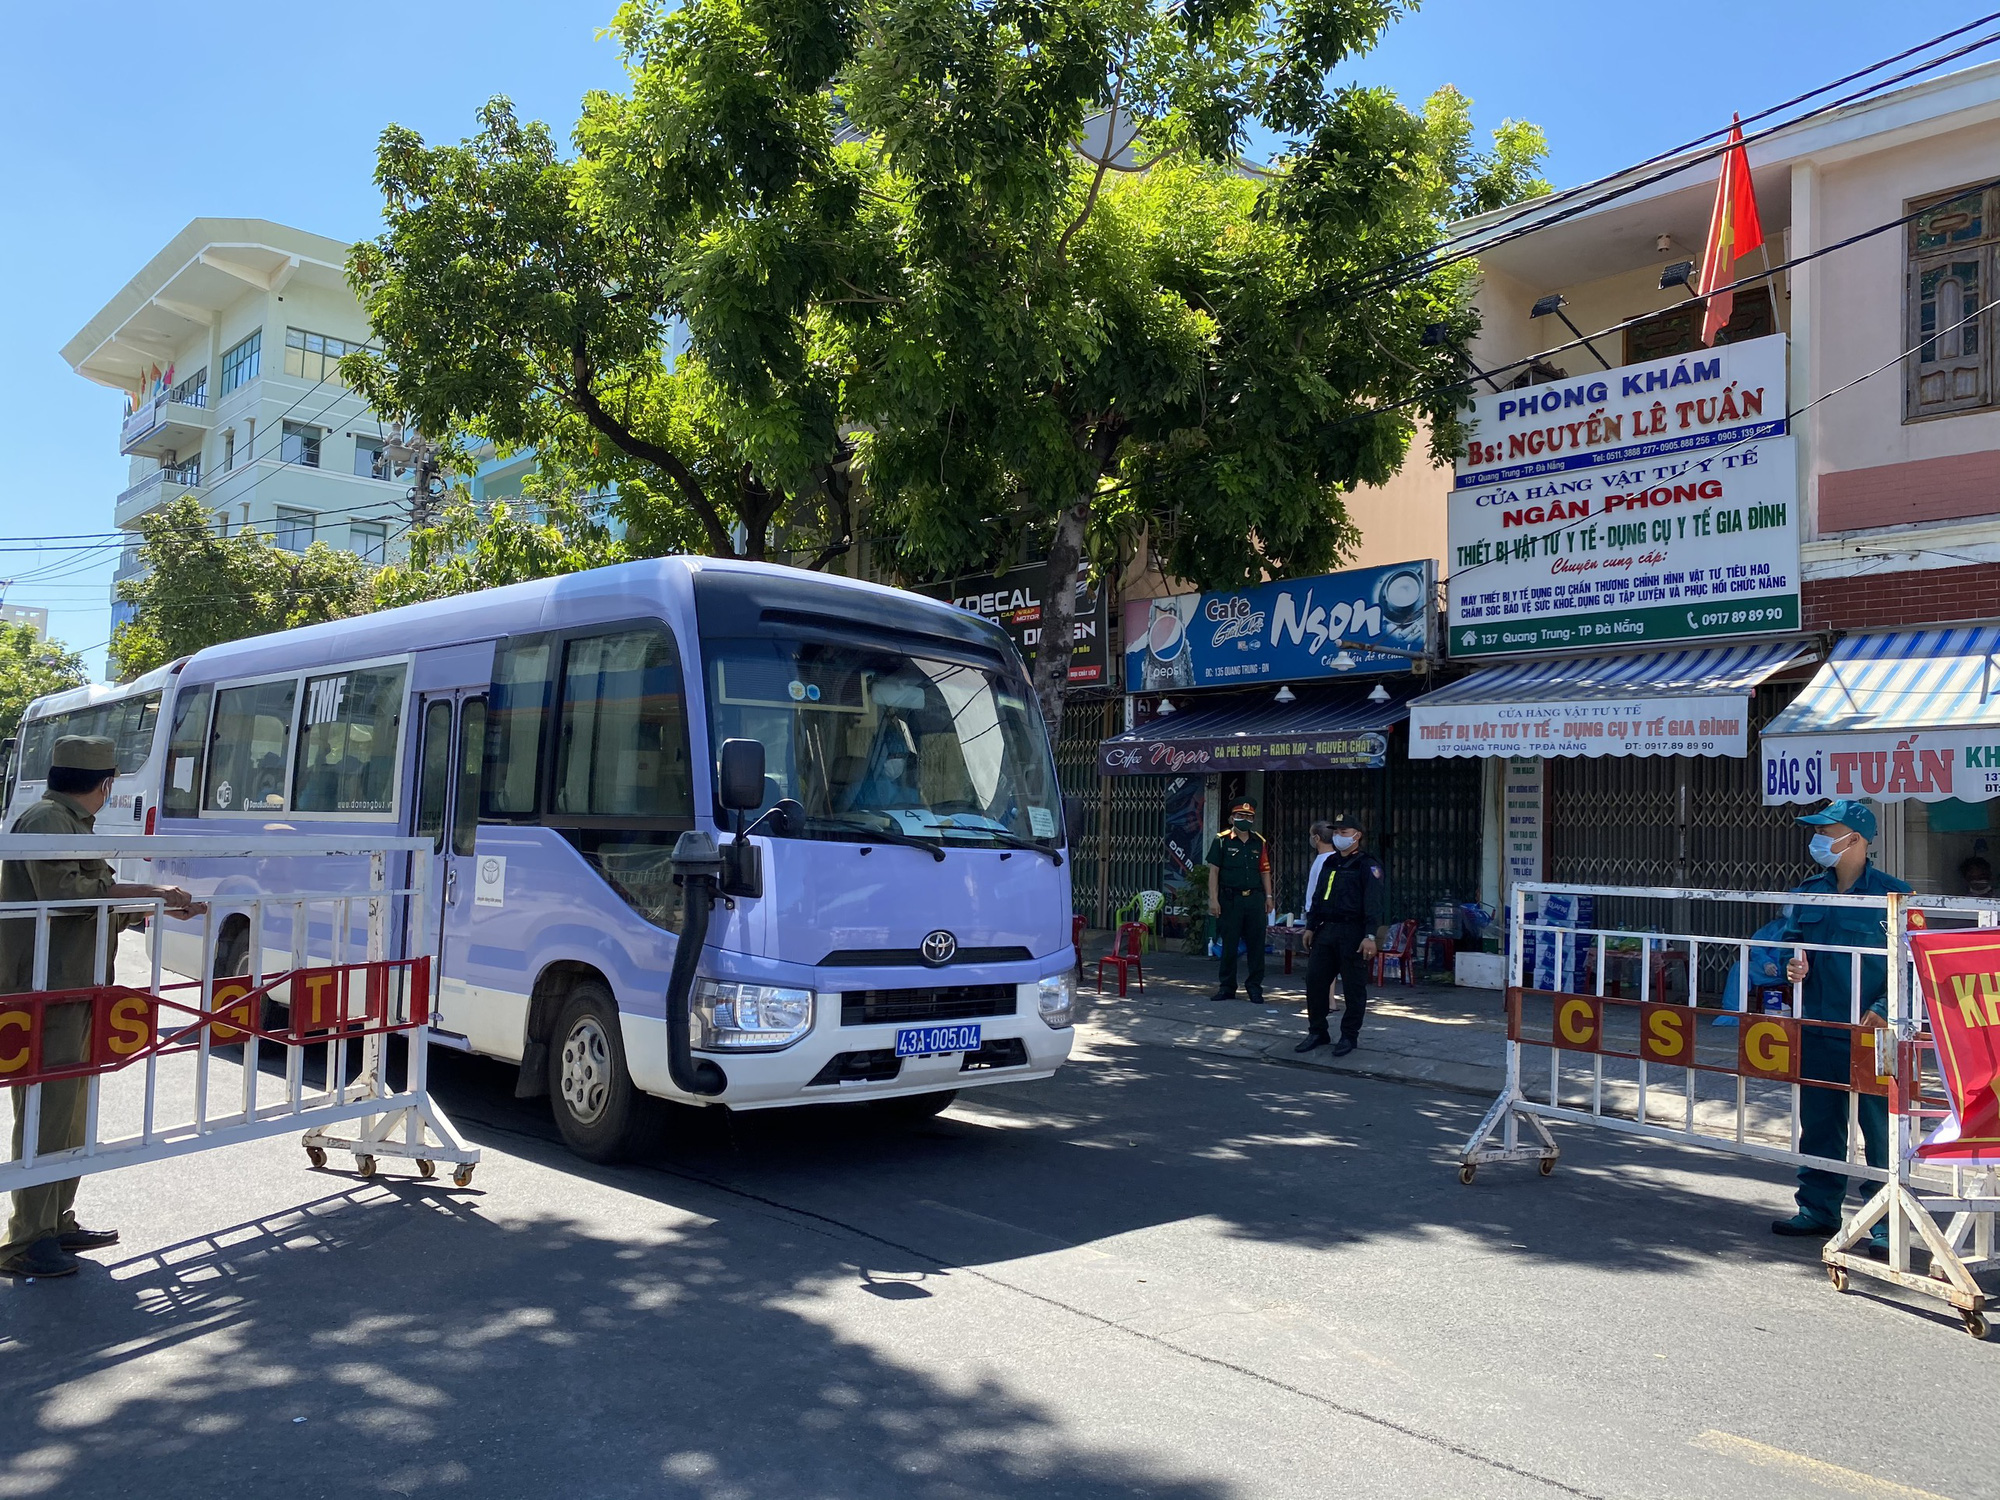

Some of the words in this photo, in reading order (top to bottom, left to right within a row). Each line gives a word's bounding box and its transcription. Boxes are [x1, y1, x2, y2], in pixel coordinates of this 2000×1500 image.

[1499, 381, 1608, 422] PHÒNG
[1622, 358, 1721, 398] KHÁM
[1467, 441, 1503, 466] Bs:
[1508, 408, 1623, 459] NGUYỄN
[1632, 400, 1667, 437] LÊ
[1675, 380, 1765, 430] TUẤN
[1464, 475, 1475, 485] 137
[1478, 470, 1499, 483] Quang
[1501, 467, 1520, 480] Trung
[1535, 463, 1546, 473] Đà
[1546, 460, 1565, 472] Nẵng
[1695, 435, 1710, 446] 256
[1476, 488, 1520, 507] CỬA
[1526, 478, 1593, 500] HÀNG
[1601, 470, 1646, 489] VẬT
[1696, 457, 1714, 473] Y
[1722, 446, 1758, 470] TẾ
[1503, 499, 1590, 528] NGÂN
[1604, 479, 1723, 513] PHONG
[1457, 538, 1491, 567] THIẾT
[1495, 540, 1509, 564] BỊ
[1513, 534, 1537, 562] VẬT
[1542, 530, 1561, 556] TƯ
[1567, 531, 1575, 553] Y
[1580, 522, 1598, 551] TẾ
[1608, 522, 1647, 550] DỤNG
[1652, 518, 1672, 545] CỤ
[1677, 516, 1686, 539] Y
[1692, 506, 1713, 538] TẾ
[1716, 508, 1743, 534] GIA
[1748, 501, 1787, 530] ĐÌNH
[1551, 557, 1599, 575] Chuyên
[1602, 556, 1634, 571] cung
[1638, 549, 1668, 567] cấp:
[1461, 593, 1477, 606] MÁY
[1479, 589, 1500, 605] THIẾT
[1502, 591, 1510, 604] BỊ
[1512, 590, 1518, 601] Y
[1519, 586, 1529, 600] TẾ
[1531, 586, 1552, 601] DỤNG
[1554, 585, 1566, 598] CỤ
[1568, 580, 1591, 596] CHẤN
[1595, 578, 1630, 593] THƯƠNG
[1633, 572, 1659, 588] CHỈNH
[1663, 570, 1684, 585] HÌNH
[1689, 568, 1704, 584] VẬT
[1708, 567, 1722, 581] TƯ
[1726, 564, 1747, 579] TIÊU
[1750, 562, 1770, 576] HAO
[1461, 606, 1483, 619] CHĂM
[1485, 603, 1501, 616] SÓC
[1503, 600, 1519, 615] BẢO
[1521, 599, 1532, 614] VỆ
[1534, 597, 1550, 612] SỨC
[1603, 593, 1615, 606] CỤ
[1618, 590, 1635, 604] TẬP
[1638, 587, 1665, 602] LUYỆN
[1669, 584, 1680, 598] VÀ
[1684, 583, 1708, 597] PHỤC
[1730, 576, 1755, 592] CHỨC
[1759, 574, 1786, 589] NĂNG
[1000, 610, 1015, 618] CAR
[1017, 608, 1035, 616] WRAP
[1016, 613, 1040, 622] MOTOR
[1205, 596, 1251, 621] Café
[1270, 587, 1382, 656] Ngon
[1481, 633, 1498, 645] 137
[1502, 630, 1537, 644] Quang
[1578, 624, 1592, 637] TP
[1595, 622, 1612, 635] Đà
[1613, 619, 1644, 634] Nẵng
[1701, 612, 1730, 626] 0917
[1731, 610, 1747, 624] 89
[1748, 608, 1764, 622] 89
[1765, 607, 1783, 620] 90
[1152, 665, 1182, 679] pepsi
[1214, 666, 1224, 677] 135
[1224, 665, 1242, 676] QUANG
[1241, 663, 1258, 675] TRUNG
[307, 676, 348, 725] TMF
[1498, 706, 1523, 718] CỬA
[1525, 707, 1560, 718] HÀNG
[1564, 705, 1589, 718] VẬT
[1592, 706, 1610, 716] TƯ
[1612, 706, 1621, 715] Y
[1624, 703, 1642, 715] TẾ
[1419, 720, 1453, 740] THIẾT
[1456, 724, 1470, 742] BỊ
[1473, 721, 1498, 742] VẬT
[1501, 722, 1520, 739] TƯ
[1521, 723, 1531, 738] Y
[1533, 718, 1552, 738] TẾ
[1563, 721, 1603, 741] DỤNG
[1607, 721, 1628, 740] CỤ
[1632, 721, 1642, 737] Y
[1646, 715, 1667, 737] TẾ
[1668, 719, 1696, 736] GIA
[1698, 716, 1740, 736] ĐÌNH
[1437, 744, 1451, 752] 137
[1453, 743, 1485, 752] QUANG
[1487, 743, 1521, 751] TRUNG
[1558, 740, 1587, 750] NẴNG
[1625, 742, 1642, 750] ĐT:
[1644, 742, 1684, 750] 0917.89
[1686, 742, 1699, 750] 89
[1701, 742, 1714, 750] 90
[1106, 747, 1143, 768] Coffee
[1148, 742, 1211, 772] Ngon
[1214, 744, 1225, 758] CÀ
[1241, 743, 1262, 759] SẠCH
[1269, 743, 1291, 756] RANG
[1315, 738, 1348, 754] NGUYÊN
[1767, 750, 1800, 796] BÁC
[1805, 749, 1823, 796] SĨ
[1830, 734, 1955, 795] TUẤN
[903, 809, 922, 822] 4
[899, 1026, 978, 1053] 43A-005.04
